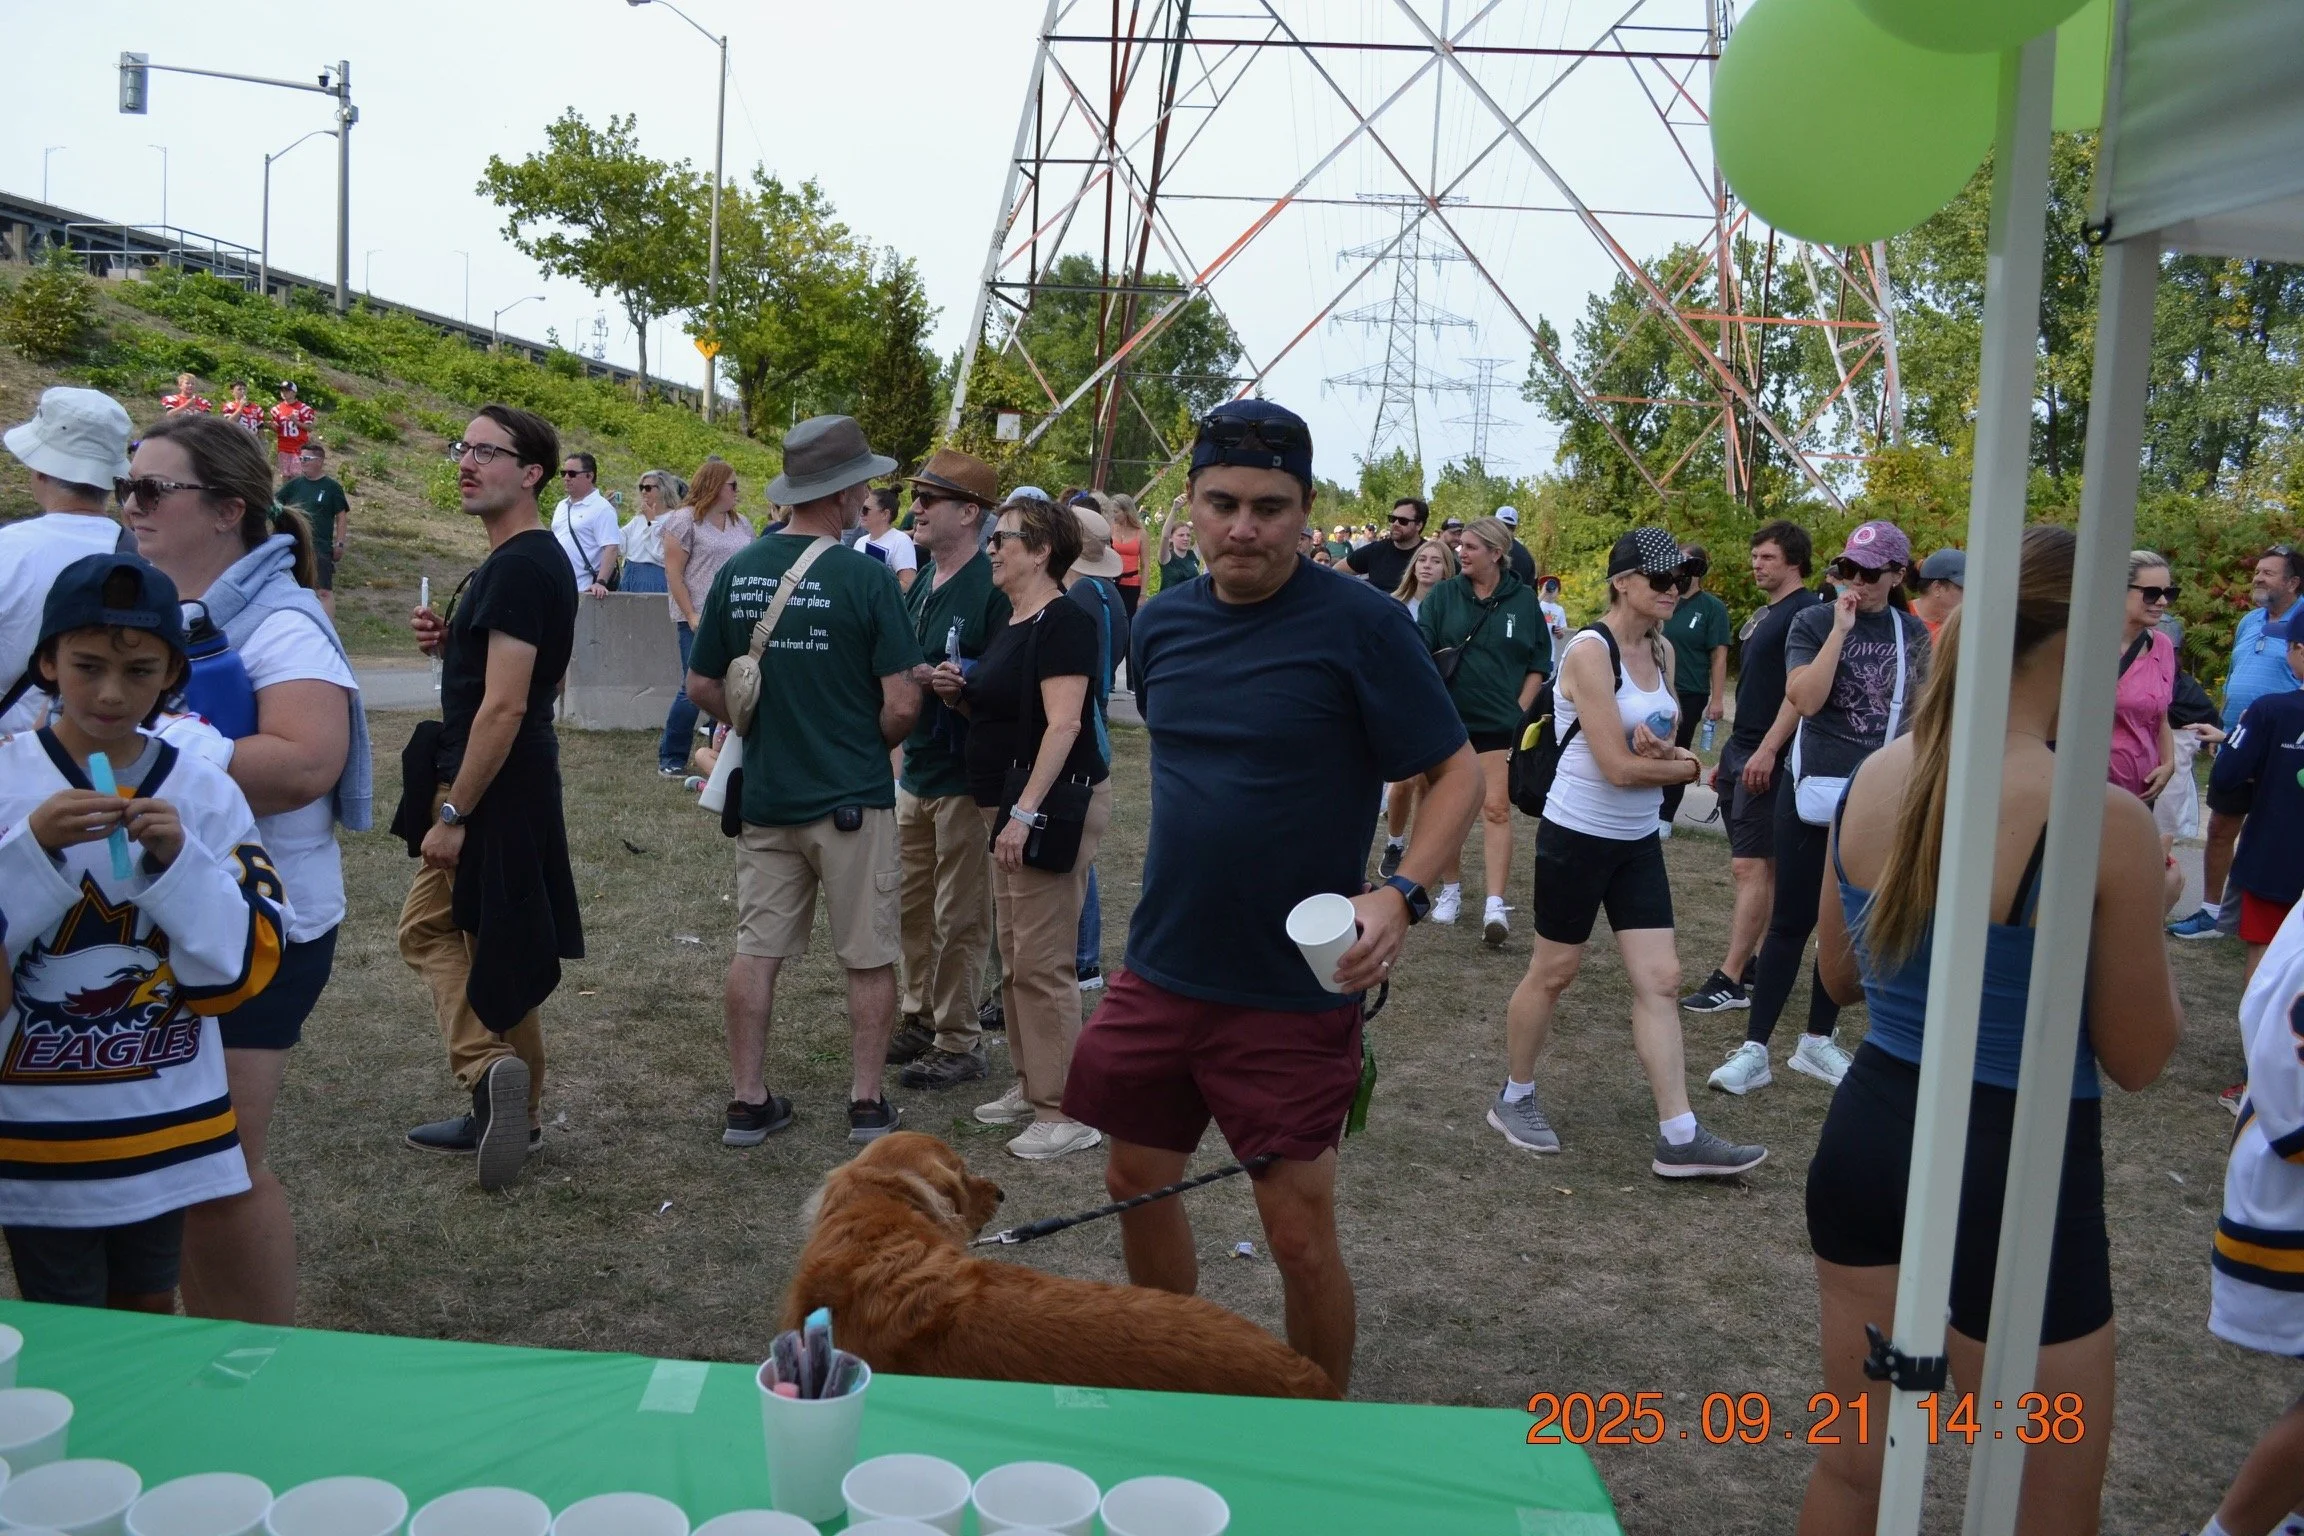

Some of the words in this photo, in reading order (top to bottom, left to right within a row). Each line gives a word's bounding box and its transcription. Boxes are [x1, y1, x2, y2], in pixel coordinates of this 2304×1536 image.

[280, 420, 299, 437] 18
[731, 575, 747, 587] Dear
[748, 576, 777, 588] person
[730, 591, 739, 603] the
[740, 589, 763, 602] world
[807, 594, 831, 609] place
[731, 606, 744, 619] with
[745, 609, 758, 620] you
[780, 639, 786, 648] in
[786, 638, 804, 649] front
[806, 639, 814, 650] of
[815, 642, 829, 652] you
[16, 1018, 201, 1071] EAGLES
